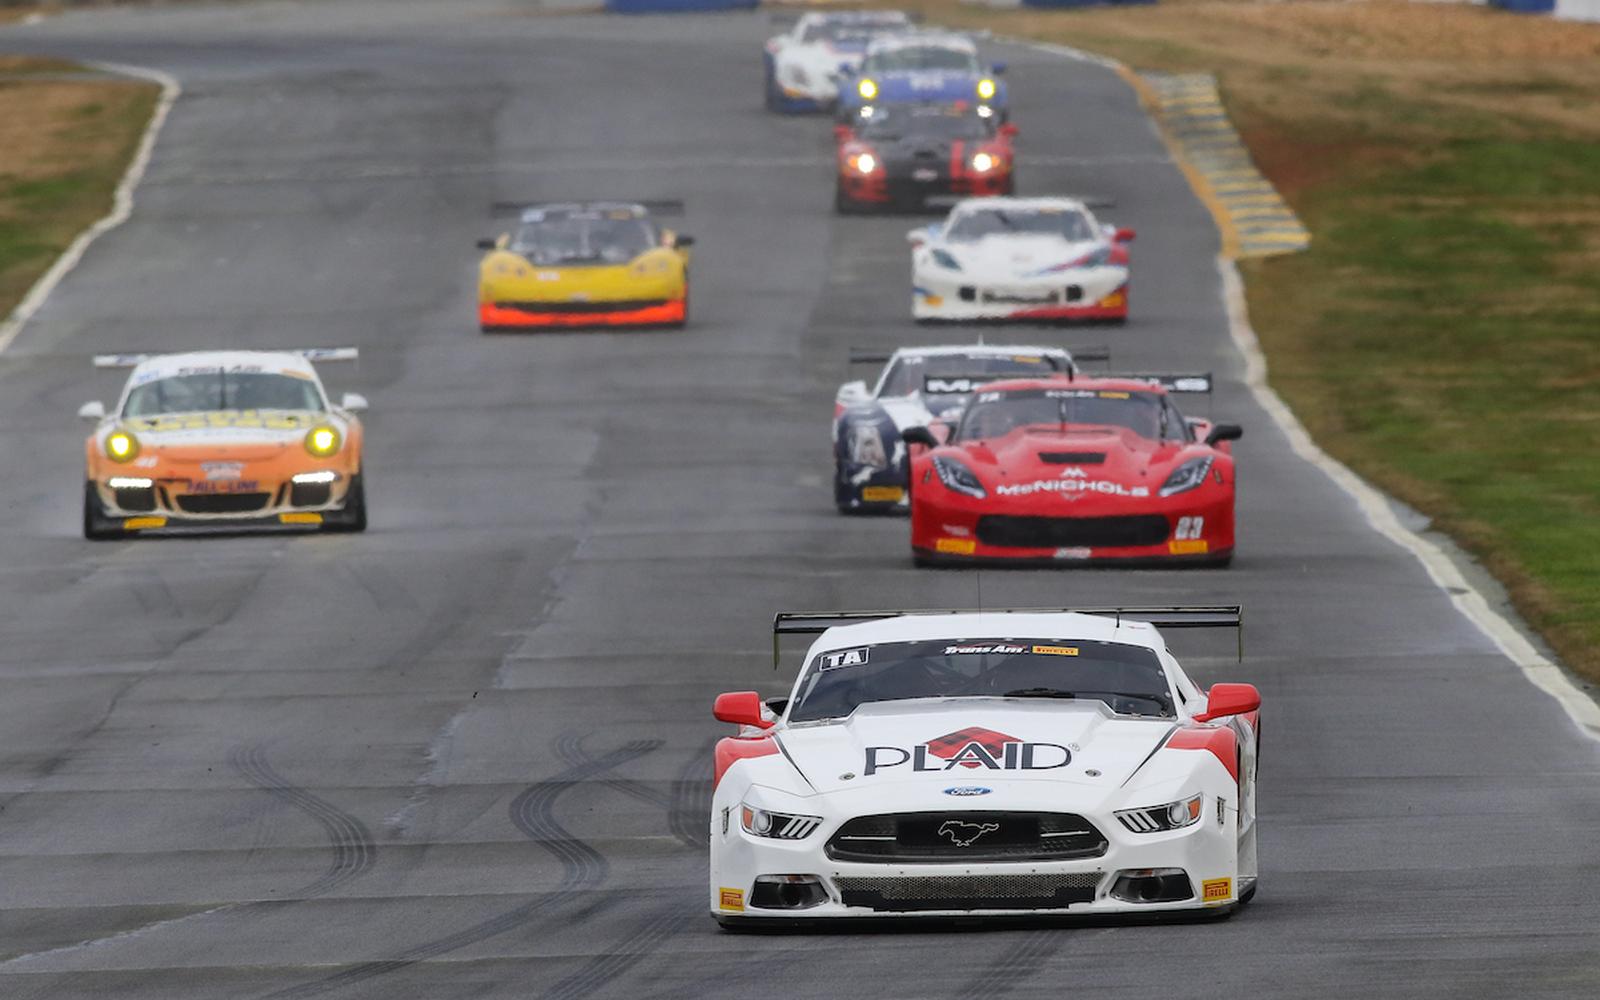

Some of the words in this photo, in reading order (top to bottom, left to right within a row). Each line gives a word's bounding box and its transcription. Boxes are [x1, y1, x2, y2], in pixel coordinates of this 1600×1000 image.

[996, 479, 1149, 497] McNICHOLS
[944, 646, 991, 655] Trans
[991, 645, 1026, 653] Am
[827, 651, 861, 667] TA
[864, 741, 1072, 776] PLAID
[949, 786, 983, 796] Ford
[1204, 881, 1229, 898] PIRELLI
